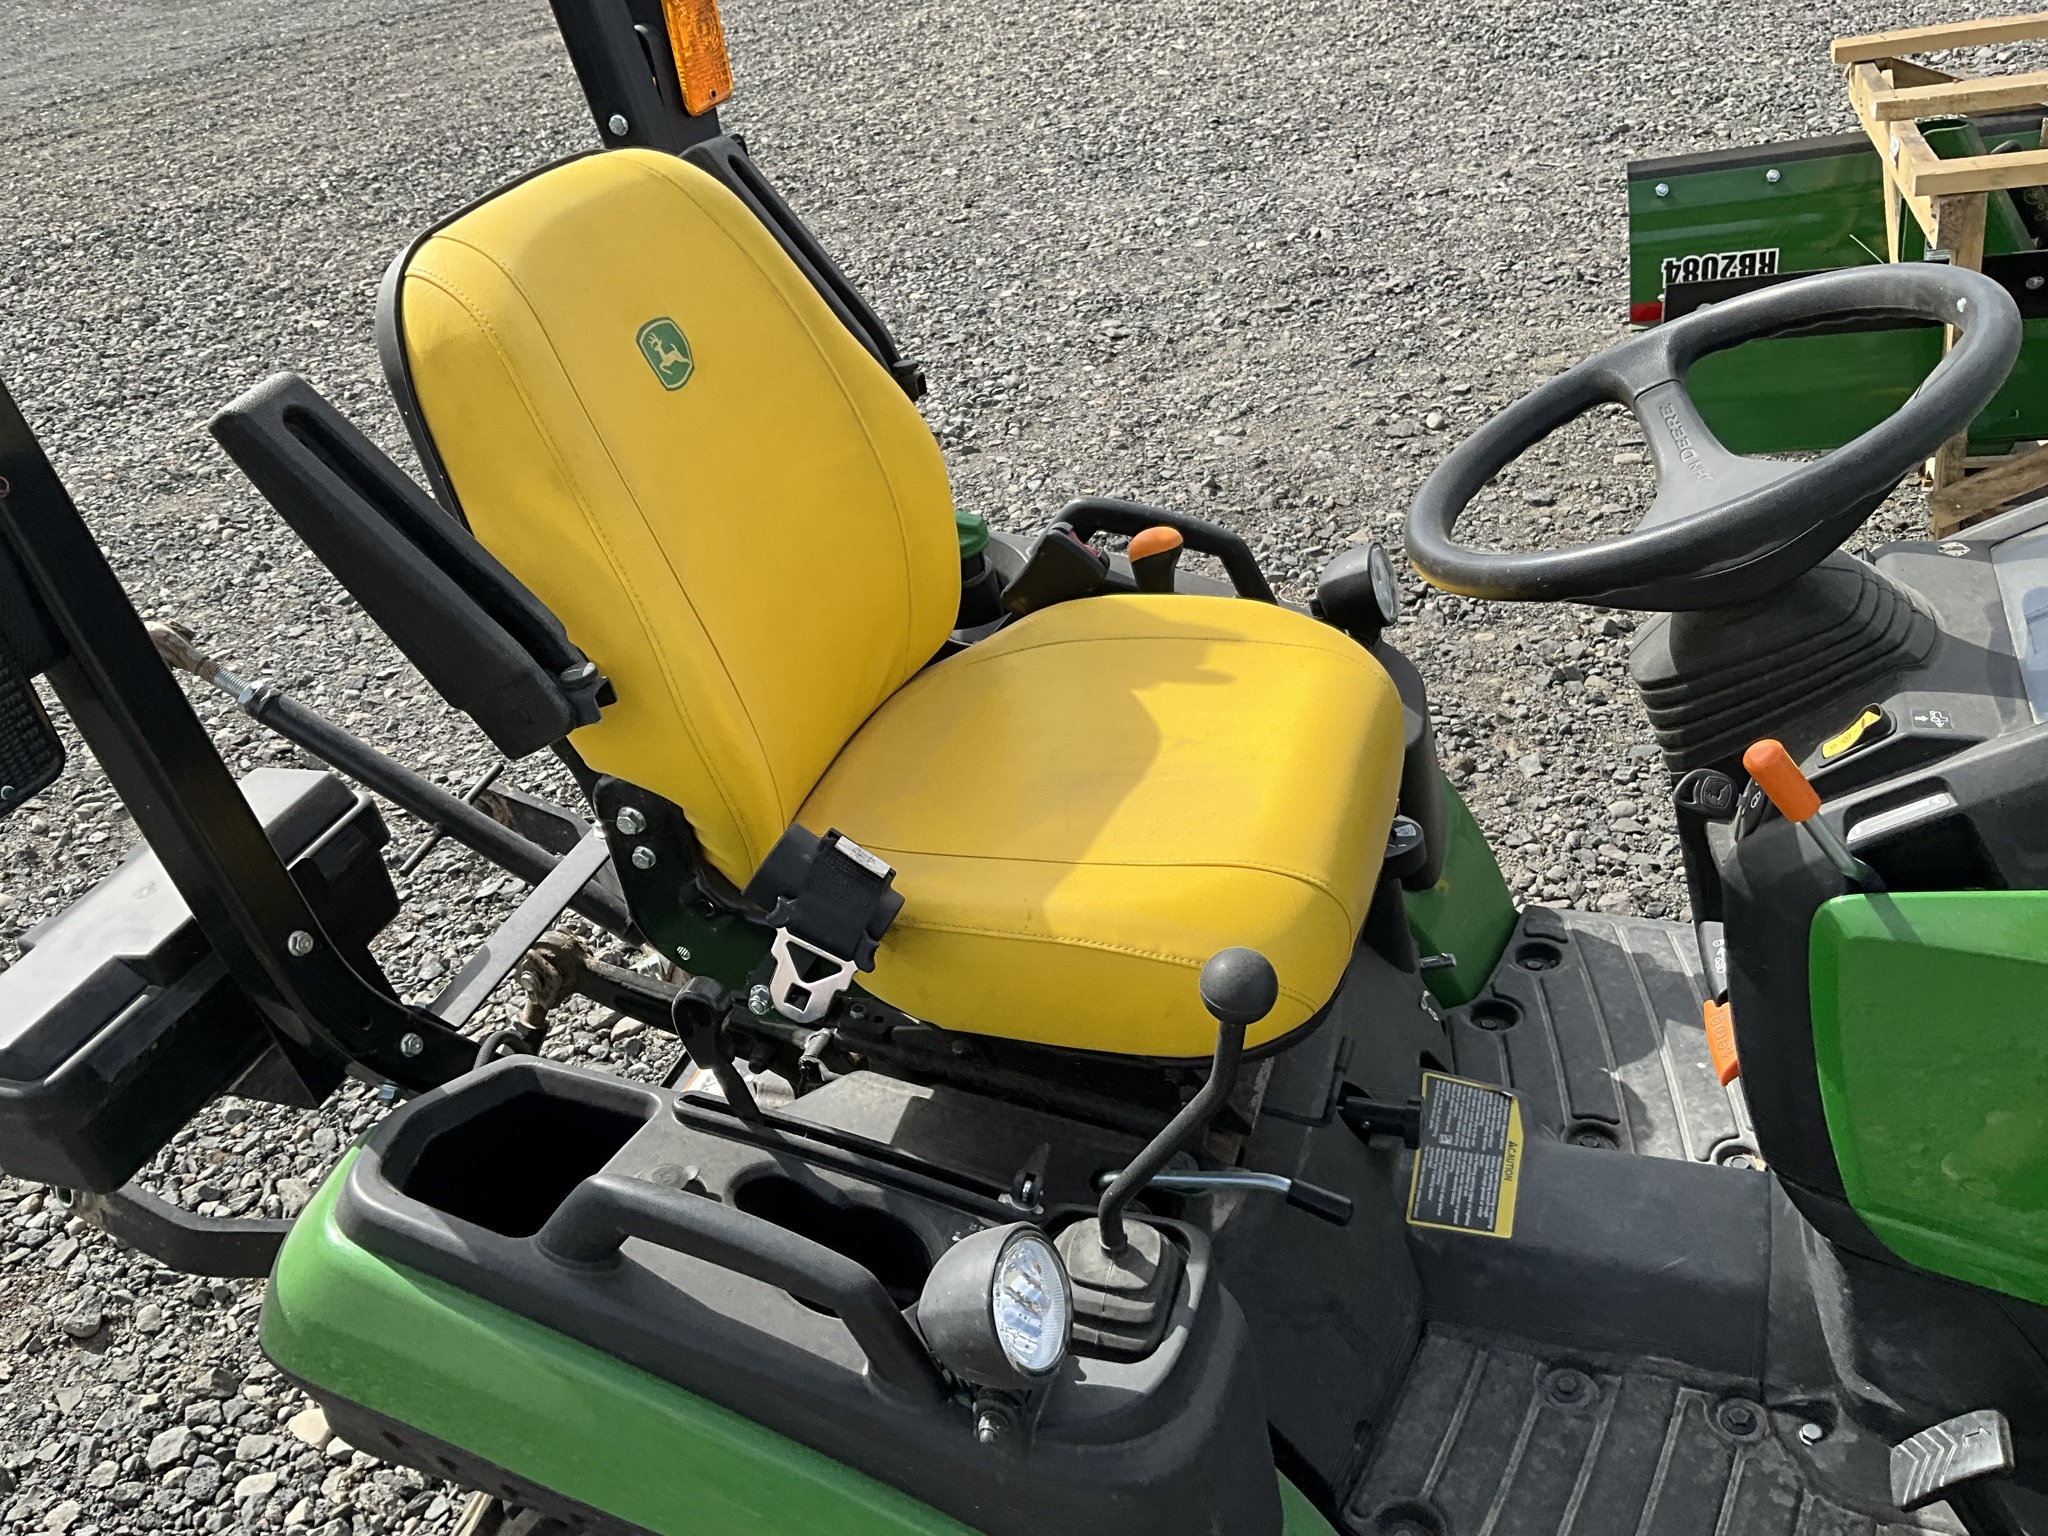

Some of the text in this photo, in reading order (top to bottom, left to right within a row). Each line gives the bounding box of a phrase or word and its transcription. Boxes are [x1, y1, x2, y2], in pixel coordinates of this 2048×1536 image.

[1664, 250, 1777, 284] RB2084
[1659, 402, 1698, 463] DEERE
[1504, 1147, 1516, 1181] CAUTION
